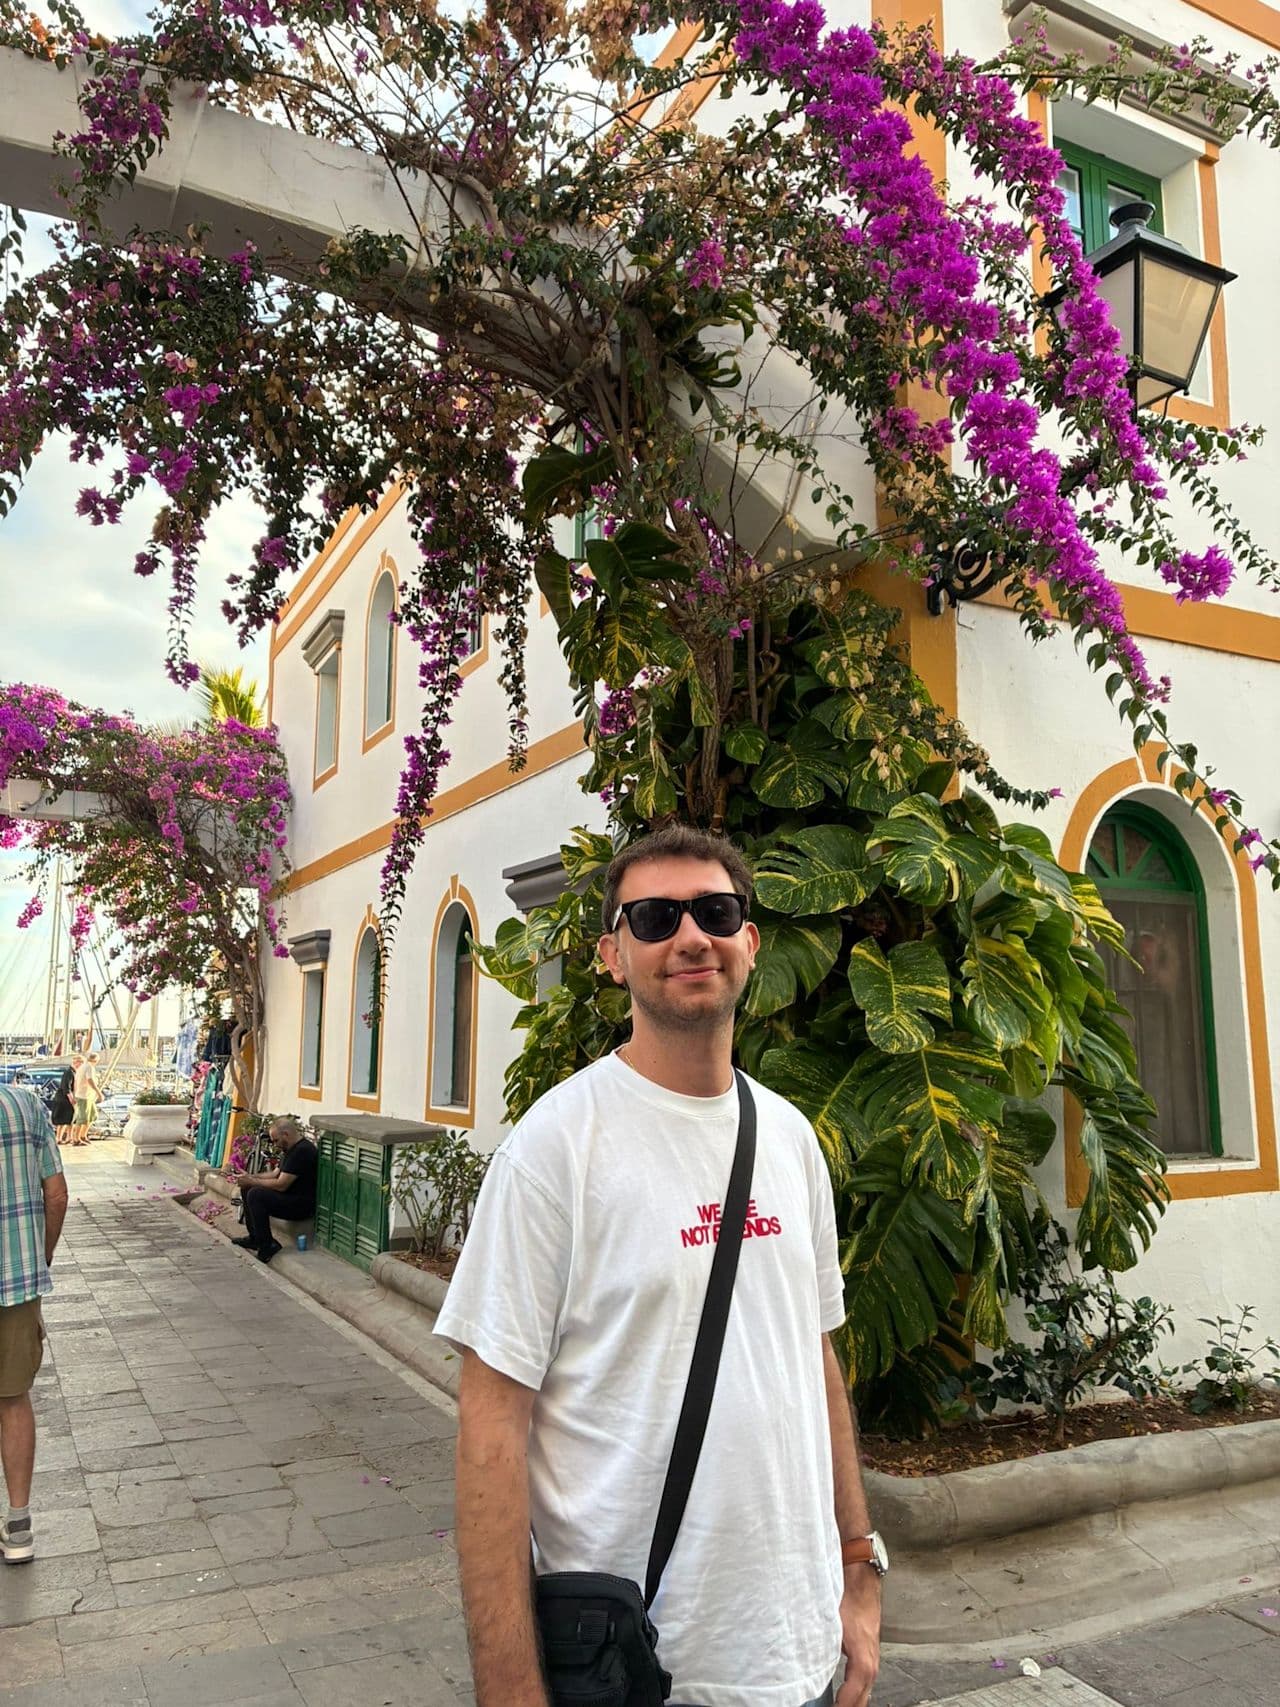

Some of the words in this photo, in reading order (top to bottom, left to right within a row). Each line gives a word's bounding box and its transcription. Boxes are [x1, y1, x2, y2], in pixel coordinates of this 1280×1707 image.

[696, 1203, 722, 1223] WE
[680, 1225, 709, 1248] NOT
[712, 1216, 782, 1242] FNDS
